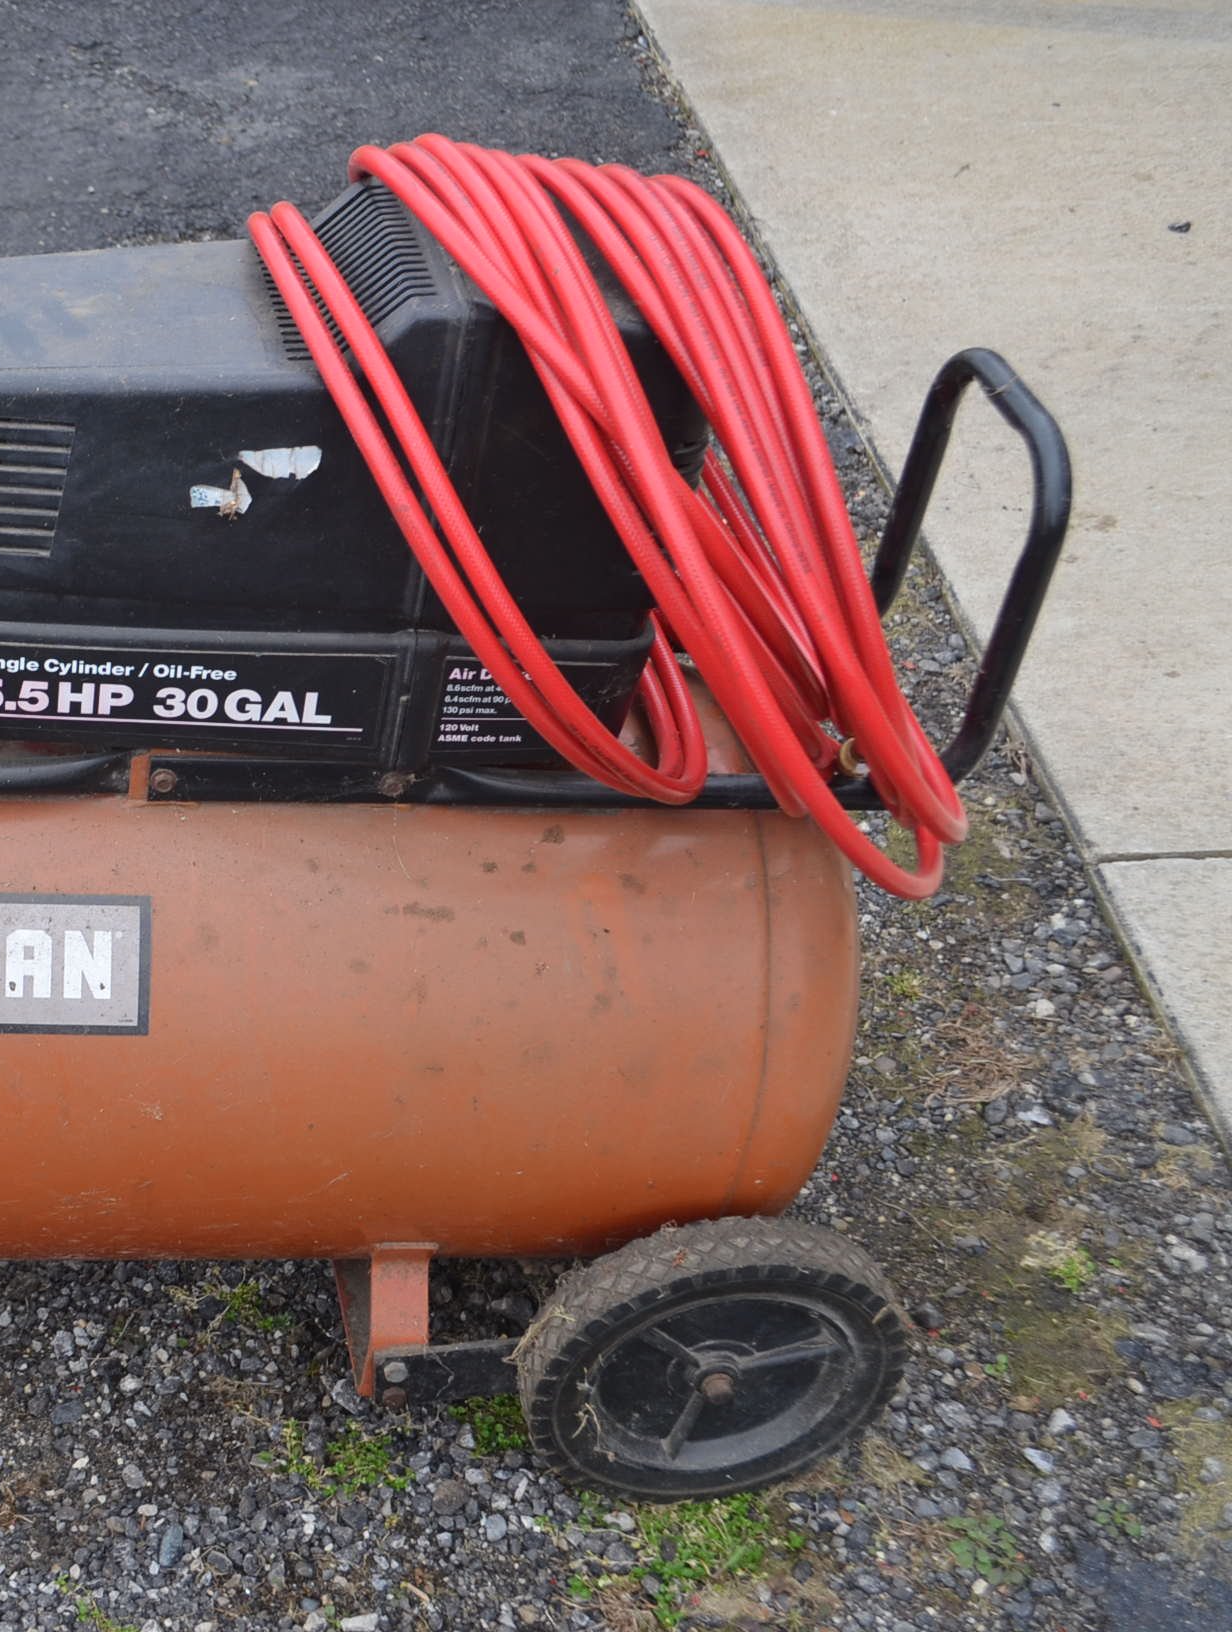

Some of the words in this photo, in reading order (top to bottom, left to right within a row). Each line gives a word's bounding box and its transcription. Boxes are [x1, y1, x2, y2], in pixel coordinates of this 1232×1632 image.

[44, 658, 134, 678] Cylinder
[138, 662, 150, 678] /
[153, 664, 237, 681] Oil-Free
[448, 667, 477, 681] Air
[484, 684, 494, 693] at
[482, 695, 492, 704] at
[493, 695, 505, 705] 90
[440, 724, 458, 733] 120
[459, 724, 480, 733] Volt
[438, 734, 469, 743] ASME
[470, 735, 497, 743] code
[499, 735, 523, 743] tank
